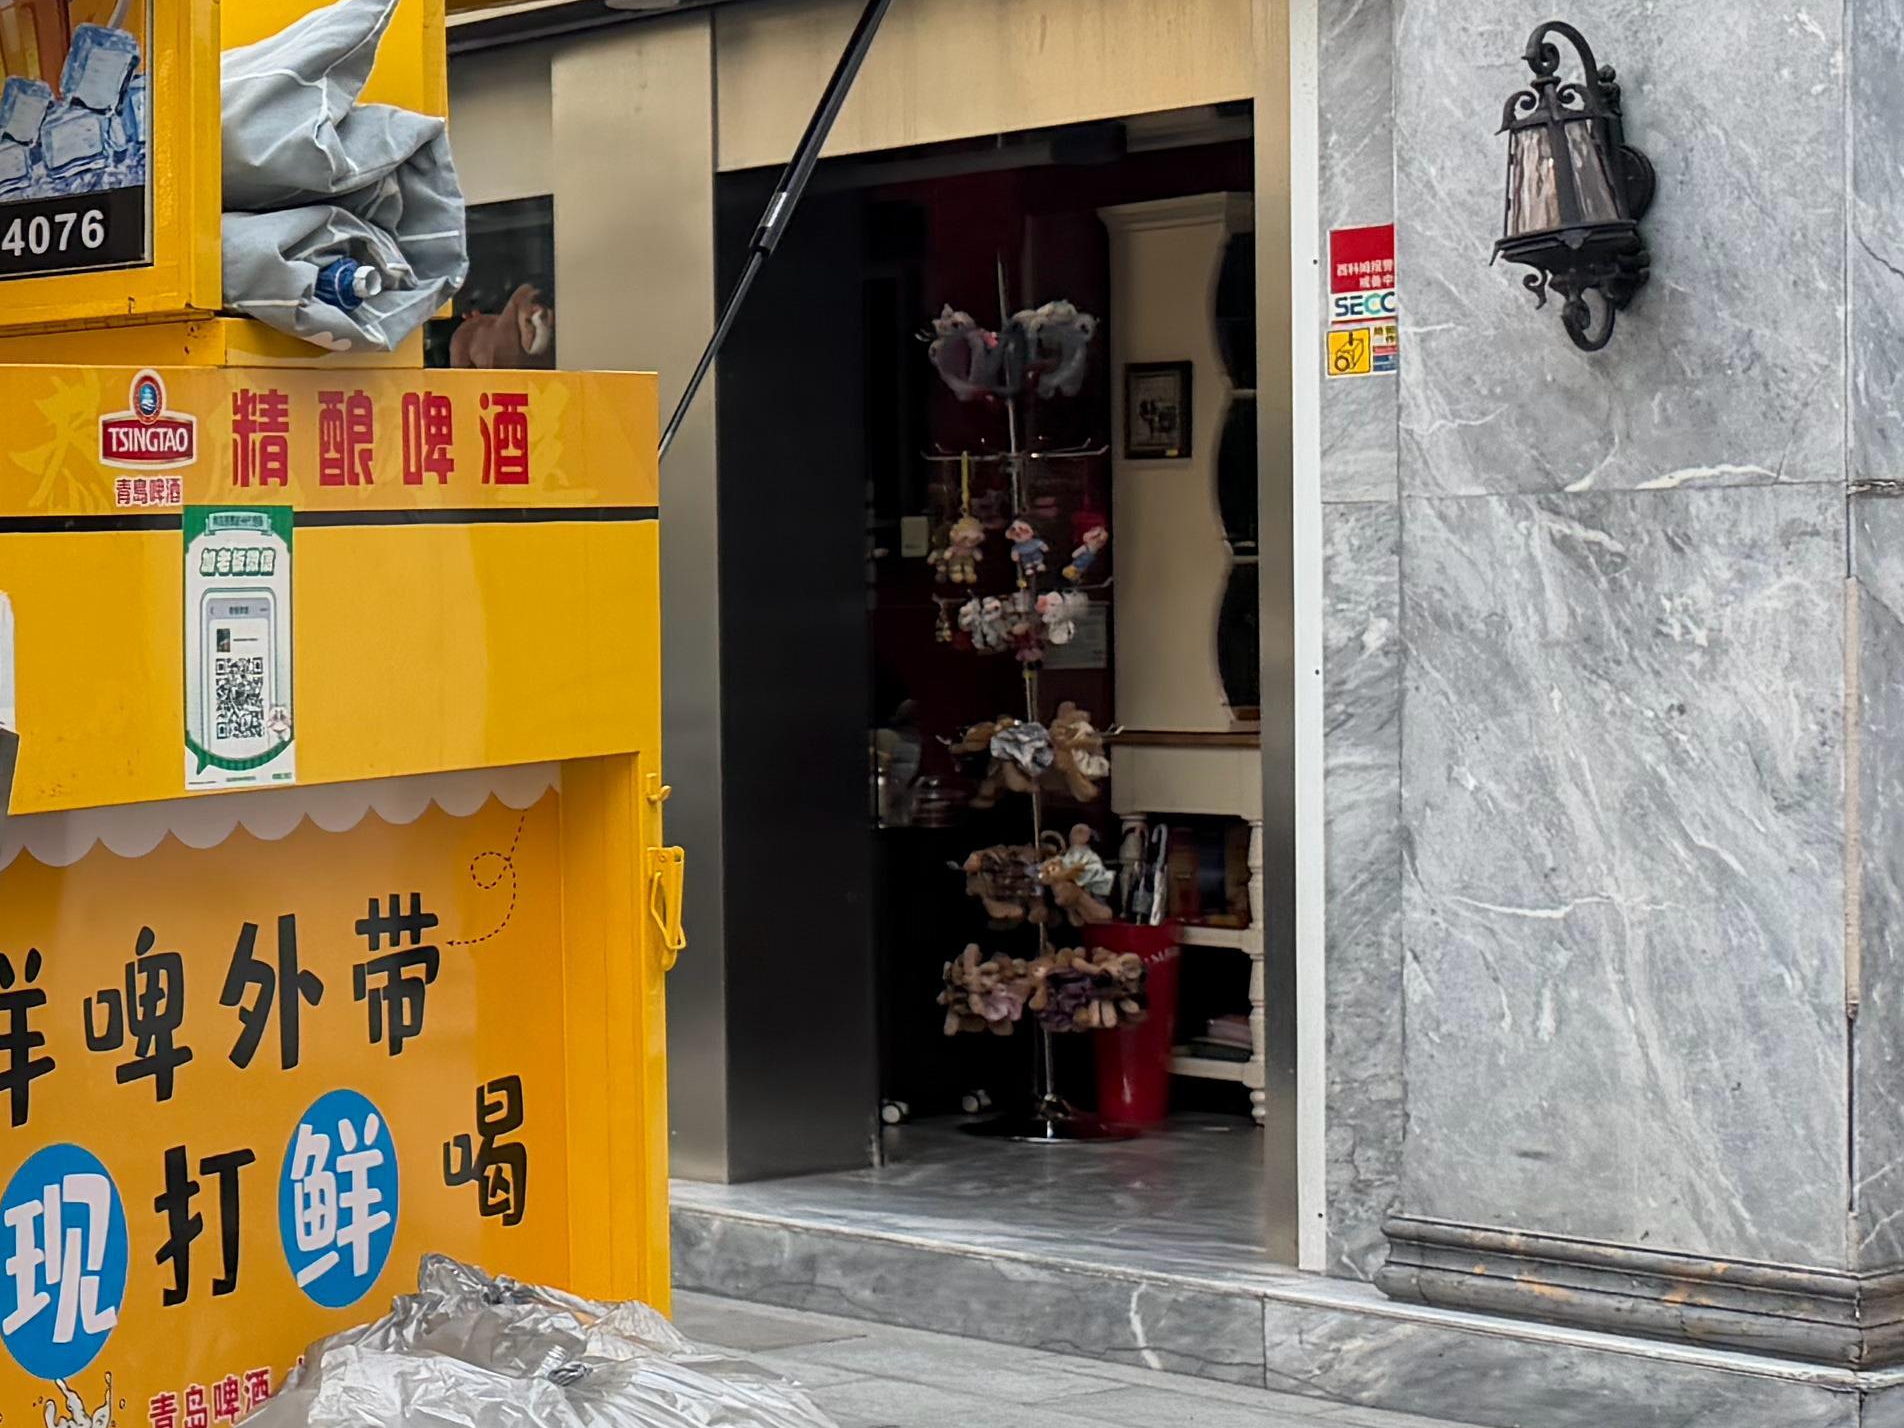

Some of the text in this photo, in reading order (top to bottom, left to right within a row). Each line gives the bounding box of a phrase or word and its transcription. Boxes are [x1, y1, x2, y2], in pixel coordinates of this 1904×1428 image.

[107, 426, 189, 455] TSINGTAO
[232, 387, 530, 488] 精酿啤酒
